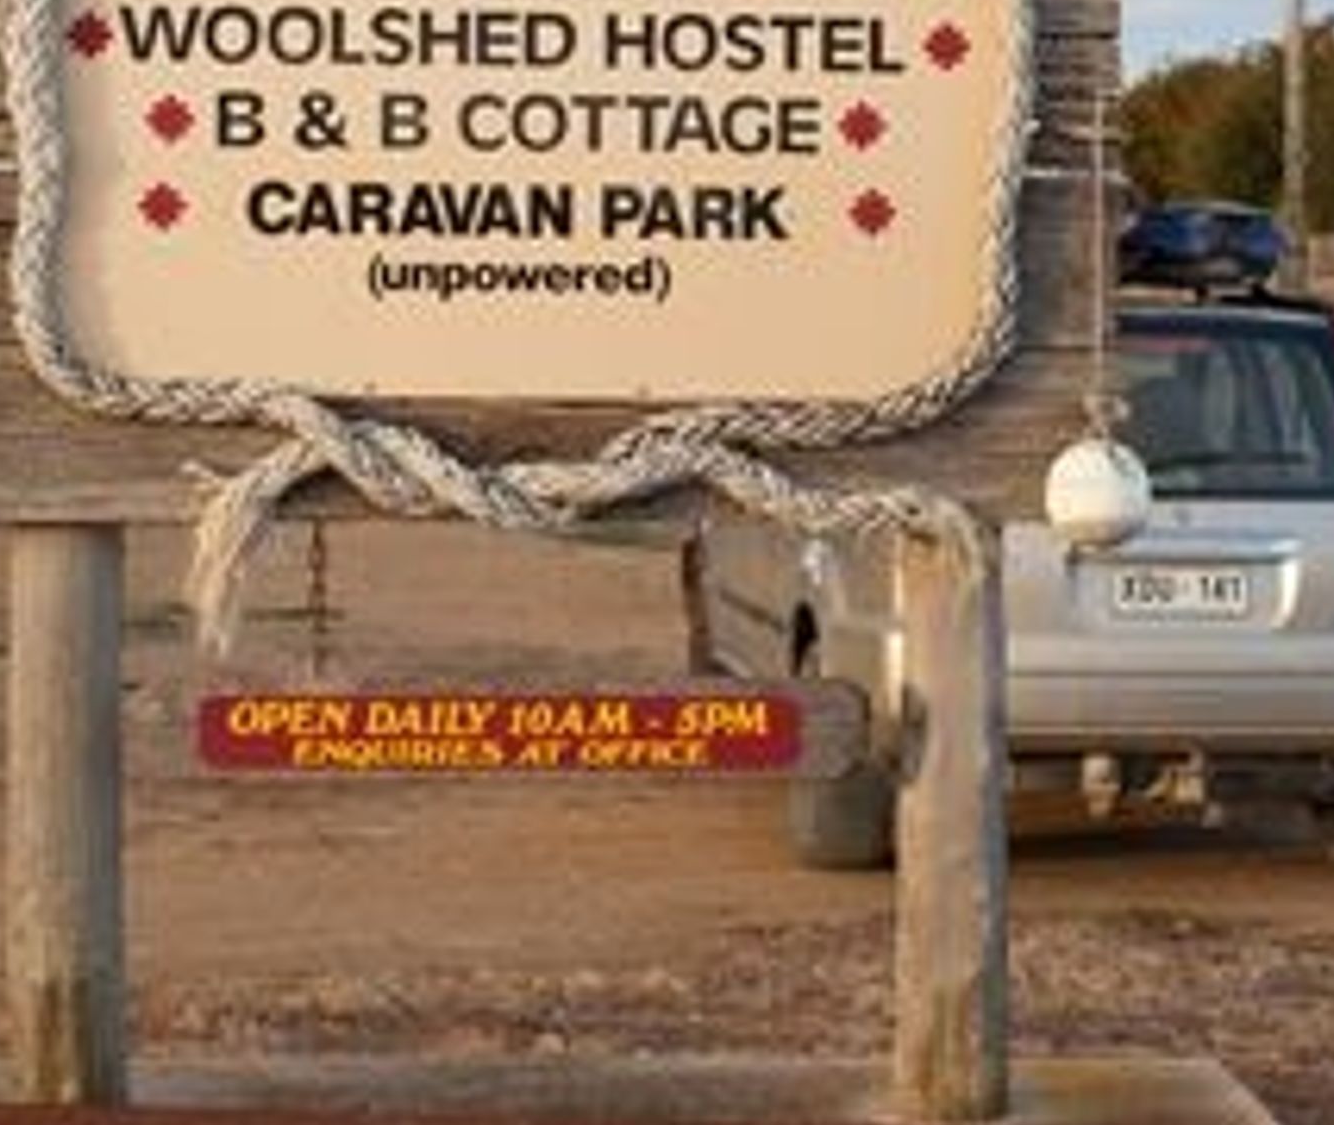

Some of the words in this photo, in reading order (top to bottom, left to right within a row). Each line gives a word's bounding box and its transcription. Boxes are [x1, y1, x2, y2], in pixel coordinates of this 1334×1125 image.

[120, 5, 578, 67] WOOLSHED
[605, 12, 905, 73] HOSTEL
[215, 92, 265, 149] B
[295, 92, 348, 150] &
[381, 93, 430, 151] B
[458, 94, 821, 155] COTTAGE
[247, 181, 573, 239] CARAVAN
[601, 185, 789, 242] PARK
[368, 254, 672, 301] (unpowered)
[228, 700, 353, 735] OPEN
[364, 700, 498, 735] DAILY
[508, 700, 631, 735] 10AM
[292, 737, 505, 768] ENQUIRIES
[517, 738, 573, 767] AT
[579, 738, 710, 767] OFFICE
